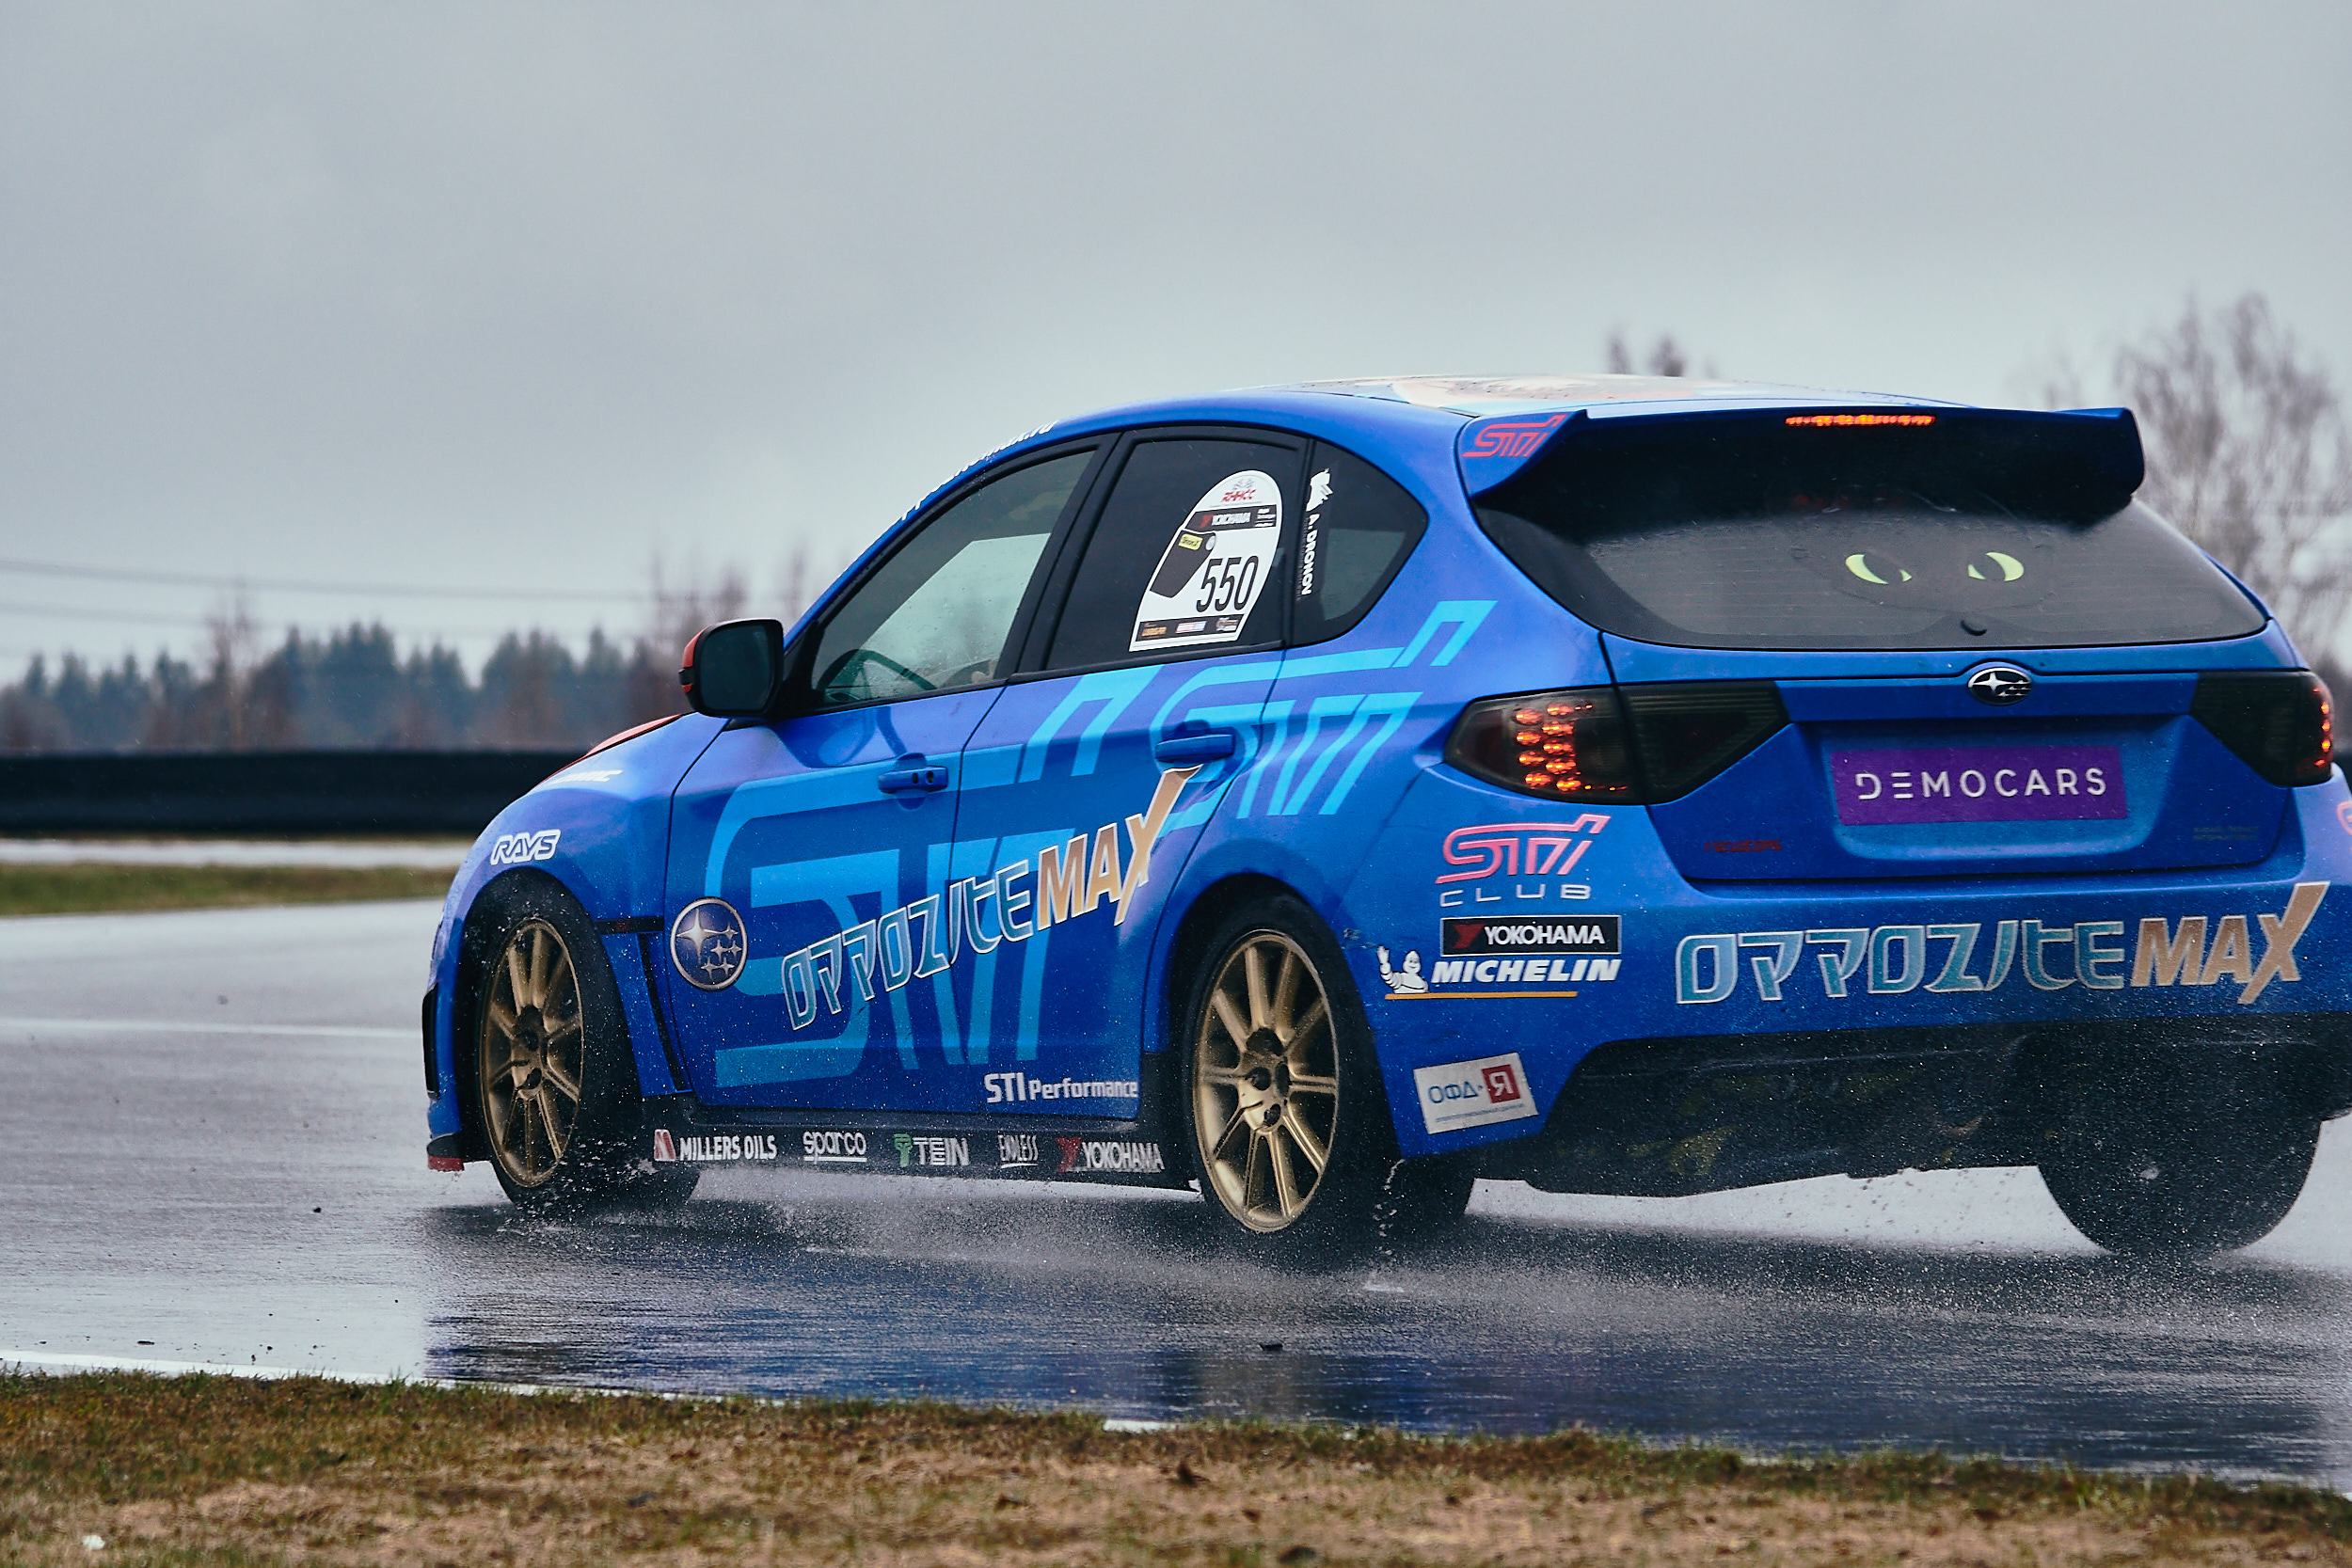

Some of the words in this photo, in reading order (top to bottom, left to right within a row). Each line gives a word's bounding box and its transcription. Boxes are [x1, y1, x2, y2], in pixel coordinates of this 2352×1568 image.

[1196, 555, 1259, 612] 550
[1854, 767, 2107, 800] DEMOCARS
[490, 829, 561, 865] RAYS
[1439, 882, 1592, 908] CLUB
[1485, 925, 1605, 945] YOKOHAMA
[1431, 958, 1622, 984] MICHELIN
[983, 1071, 1026, 1103] STI
[1028, 1077, 1138, 1101] Performance
[679, 1135, 741, 1162] MILLERS
[743, 1134, 777, 1161] OILS
[803, 1131, 867, 1164] sparco
[912, 1136, 970, 1167] TEIN
[1081, 1140, 1165, 1171] YOKOHAMA
